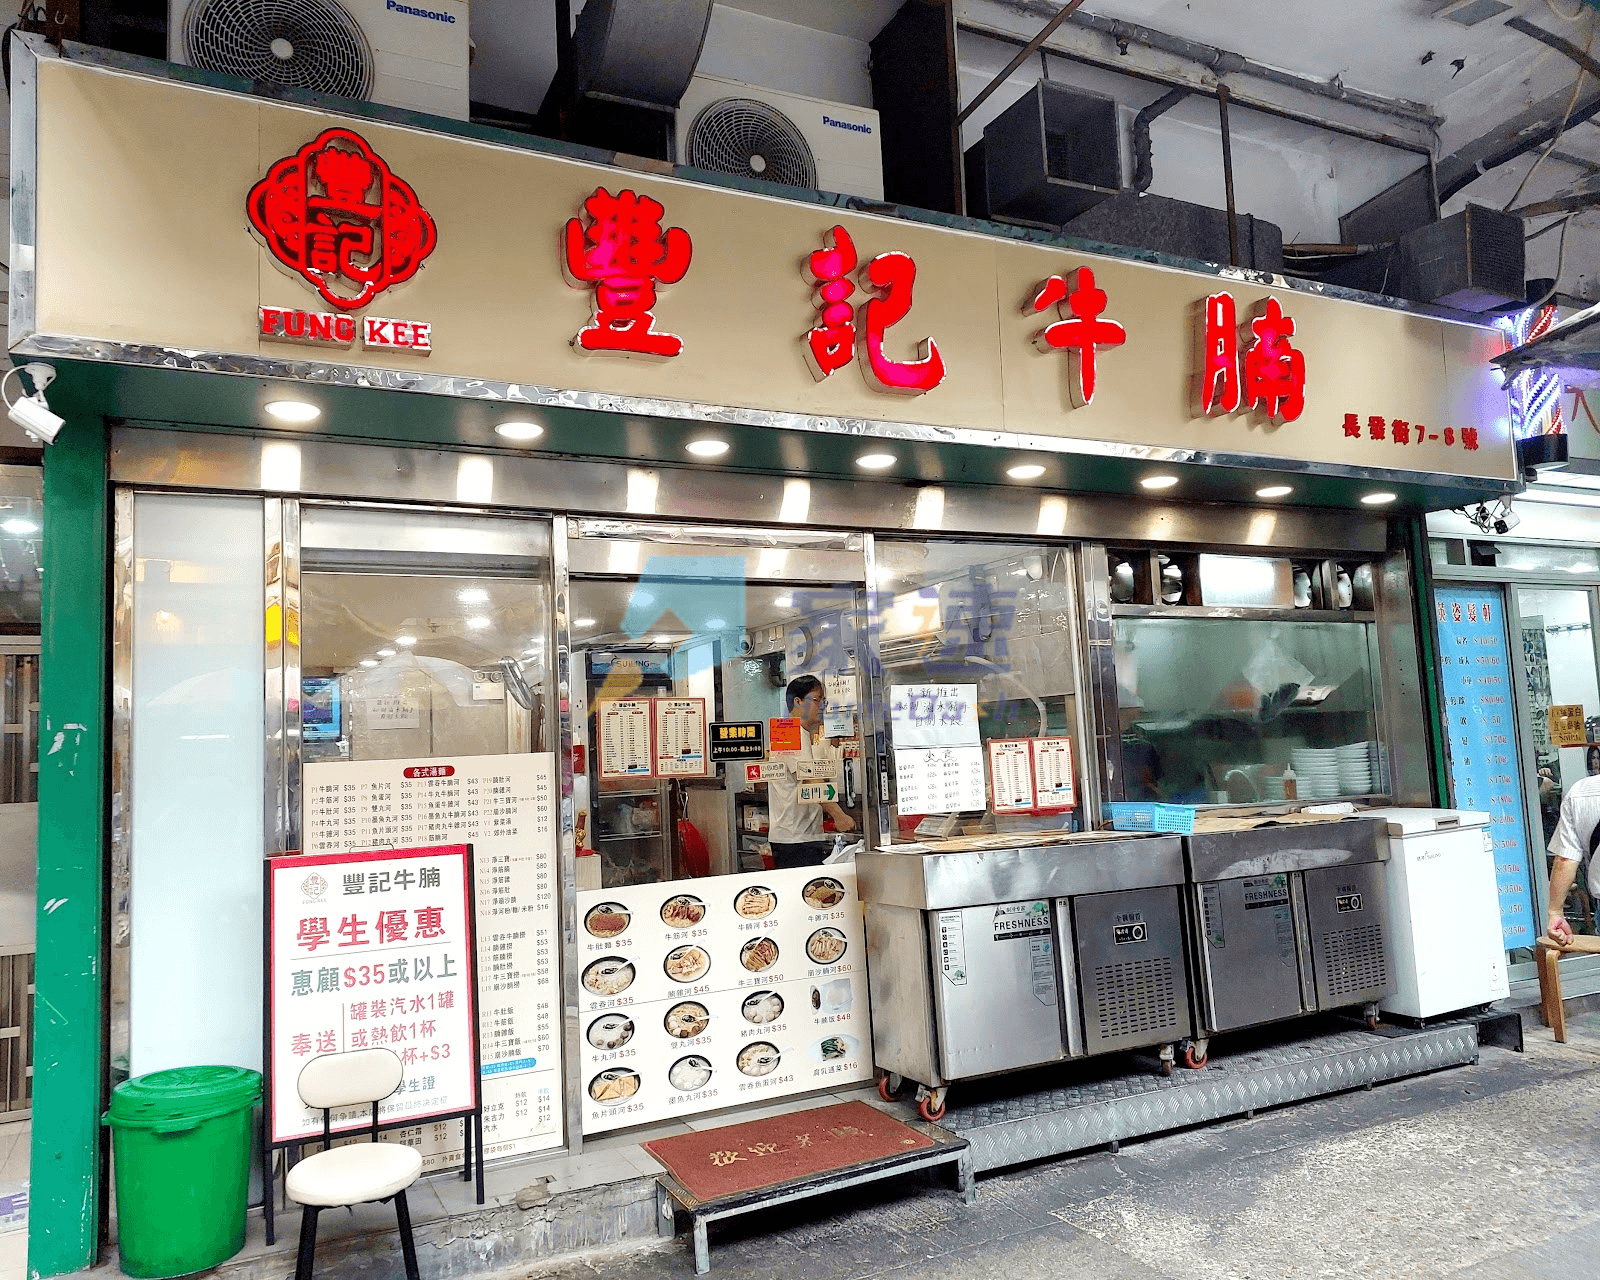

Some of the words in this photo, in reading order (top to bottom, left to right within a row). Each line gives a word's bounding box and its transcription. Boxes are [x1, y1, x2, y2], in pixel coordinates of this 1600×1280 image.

[386, 0, 456, 24] Panasonic
[822, 115, 872, 134] Panasonic
[307, 146, 384, 284] 豐記
[562, 186, 1306, 422] 豐記牛腩
[261, 308, 356, 342] FUNG
[367, 319, 429, 347] KEE
[413, 767, 446, 777] 各式湯麵
[319, 796, 339, 804] 牛筋河
[342, 867, 441, 895] 豐記牛腩
[1245, 888, 1287, 901] FRESHNESS
[297, 907, 445, 951] 學生優惠
[994, 916, 1049, 931] FRESHNESS
[692, 929, 707, 937] $35
[587, 942, 611, 951] 牛肚麵
[616, 939, 632, 947] $35
[291, 954, 457, 996] 惠顧$35或以上
[769, 974, 783, 982] $50
[694, 985, 709, 993] $45
[350, 991, 454, 1020] 罐裝汽水1罐
[617, 997, 633, 1005] $35
[837, 1013, 851, 1021] $48
[352, 1020, 436, 1048] 或熱飲1杯
[772, 1024, 787, 1032] $35
[291, 1030, 337, 1056] 奉送
[696, 1036, 711, 1044] $35
[538, 1044, 549, 1052] $70
[402, 1044, 450, 1065] 杯+$3
[592, 1052, 616, 1062] 牛丸河
[619, 1049, 636, 1058] $35
[844, 1062, 857, 1070] $16
[779, 1075, 793, 1083] $43
[702, 1089, 718, 1098] $35
[484, 1103, 504, 1112] 好立克
[516, 1099, 527, 1107] $12
[627, 1103, 644, 1112] $35
[484, 1113, 504, 1122] 朱古力
[516, 1109, 527, 1117] $12
[539, 1105, 550, 1113] $14
[400, 1128, 422, 1138] 杏仁霜
[484, 1124, 497, 1132] 汽水
[434, 1133, 447, 1141] $12
